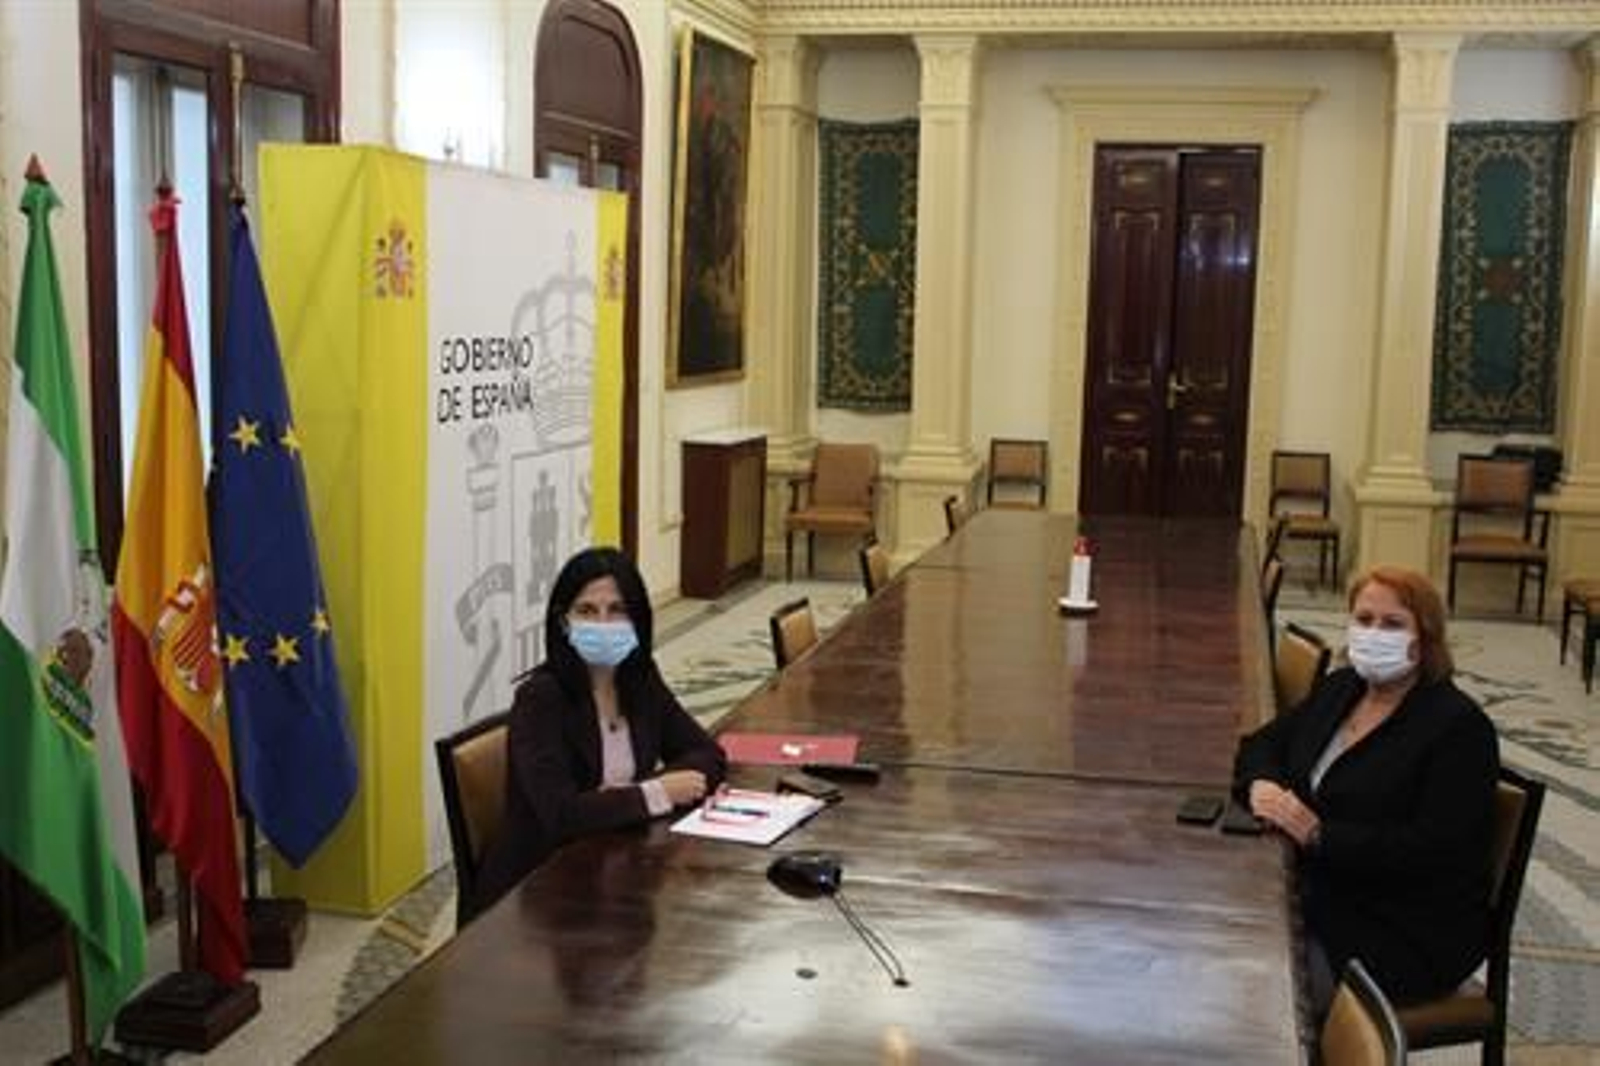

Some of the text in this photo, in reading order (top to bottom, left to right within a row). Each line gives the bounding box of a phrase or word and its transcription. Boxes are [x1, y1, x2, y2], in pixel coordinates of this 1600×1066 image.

[440, 336, 534, 374] GOBIERNO
[437, 376, 534, 422] DE ESPAÑA
